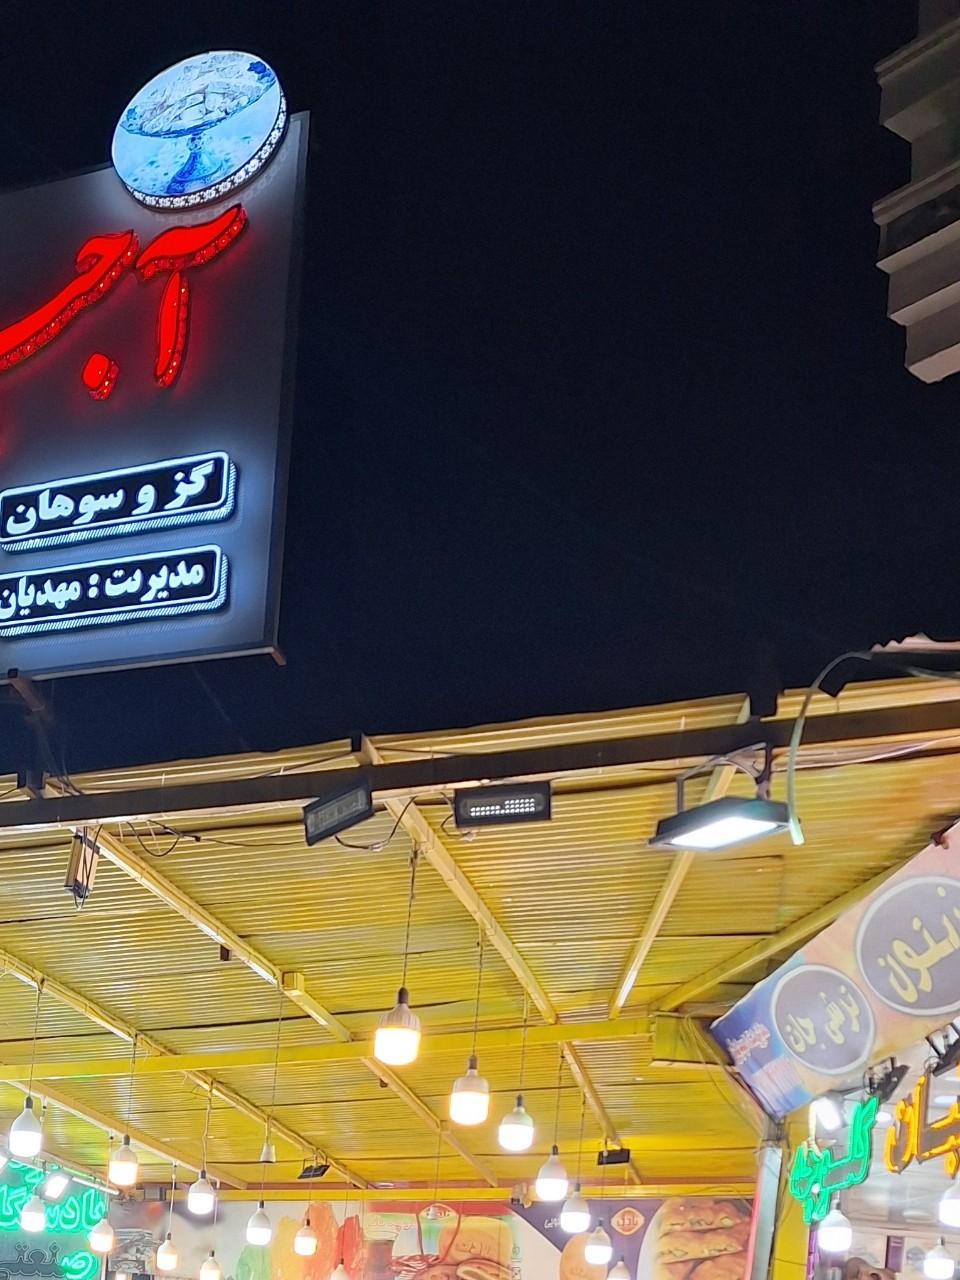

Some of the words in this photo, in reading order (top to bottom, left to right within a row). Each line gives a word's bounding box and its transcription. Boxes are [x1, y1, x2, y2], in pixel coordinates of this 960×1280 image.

[132, 484, 156, 515] و
[164, 460, 214, 510] گز
[6, 489, 125, 535] سوهان
